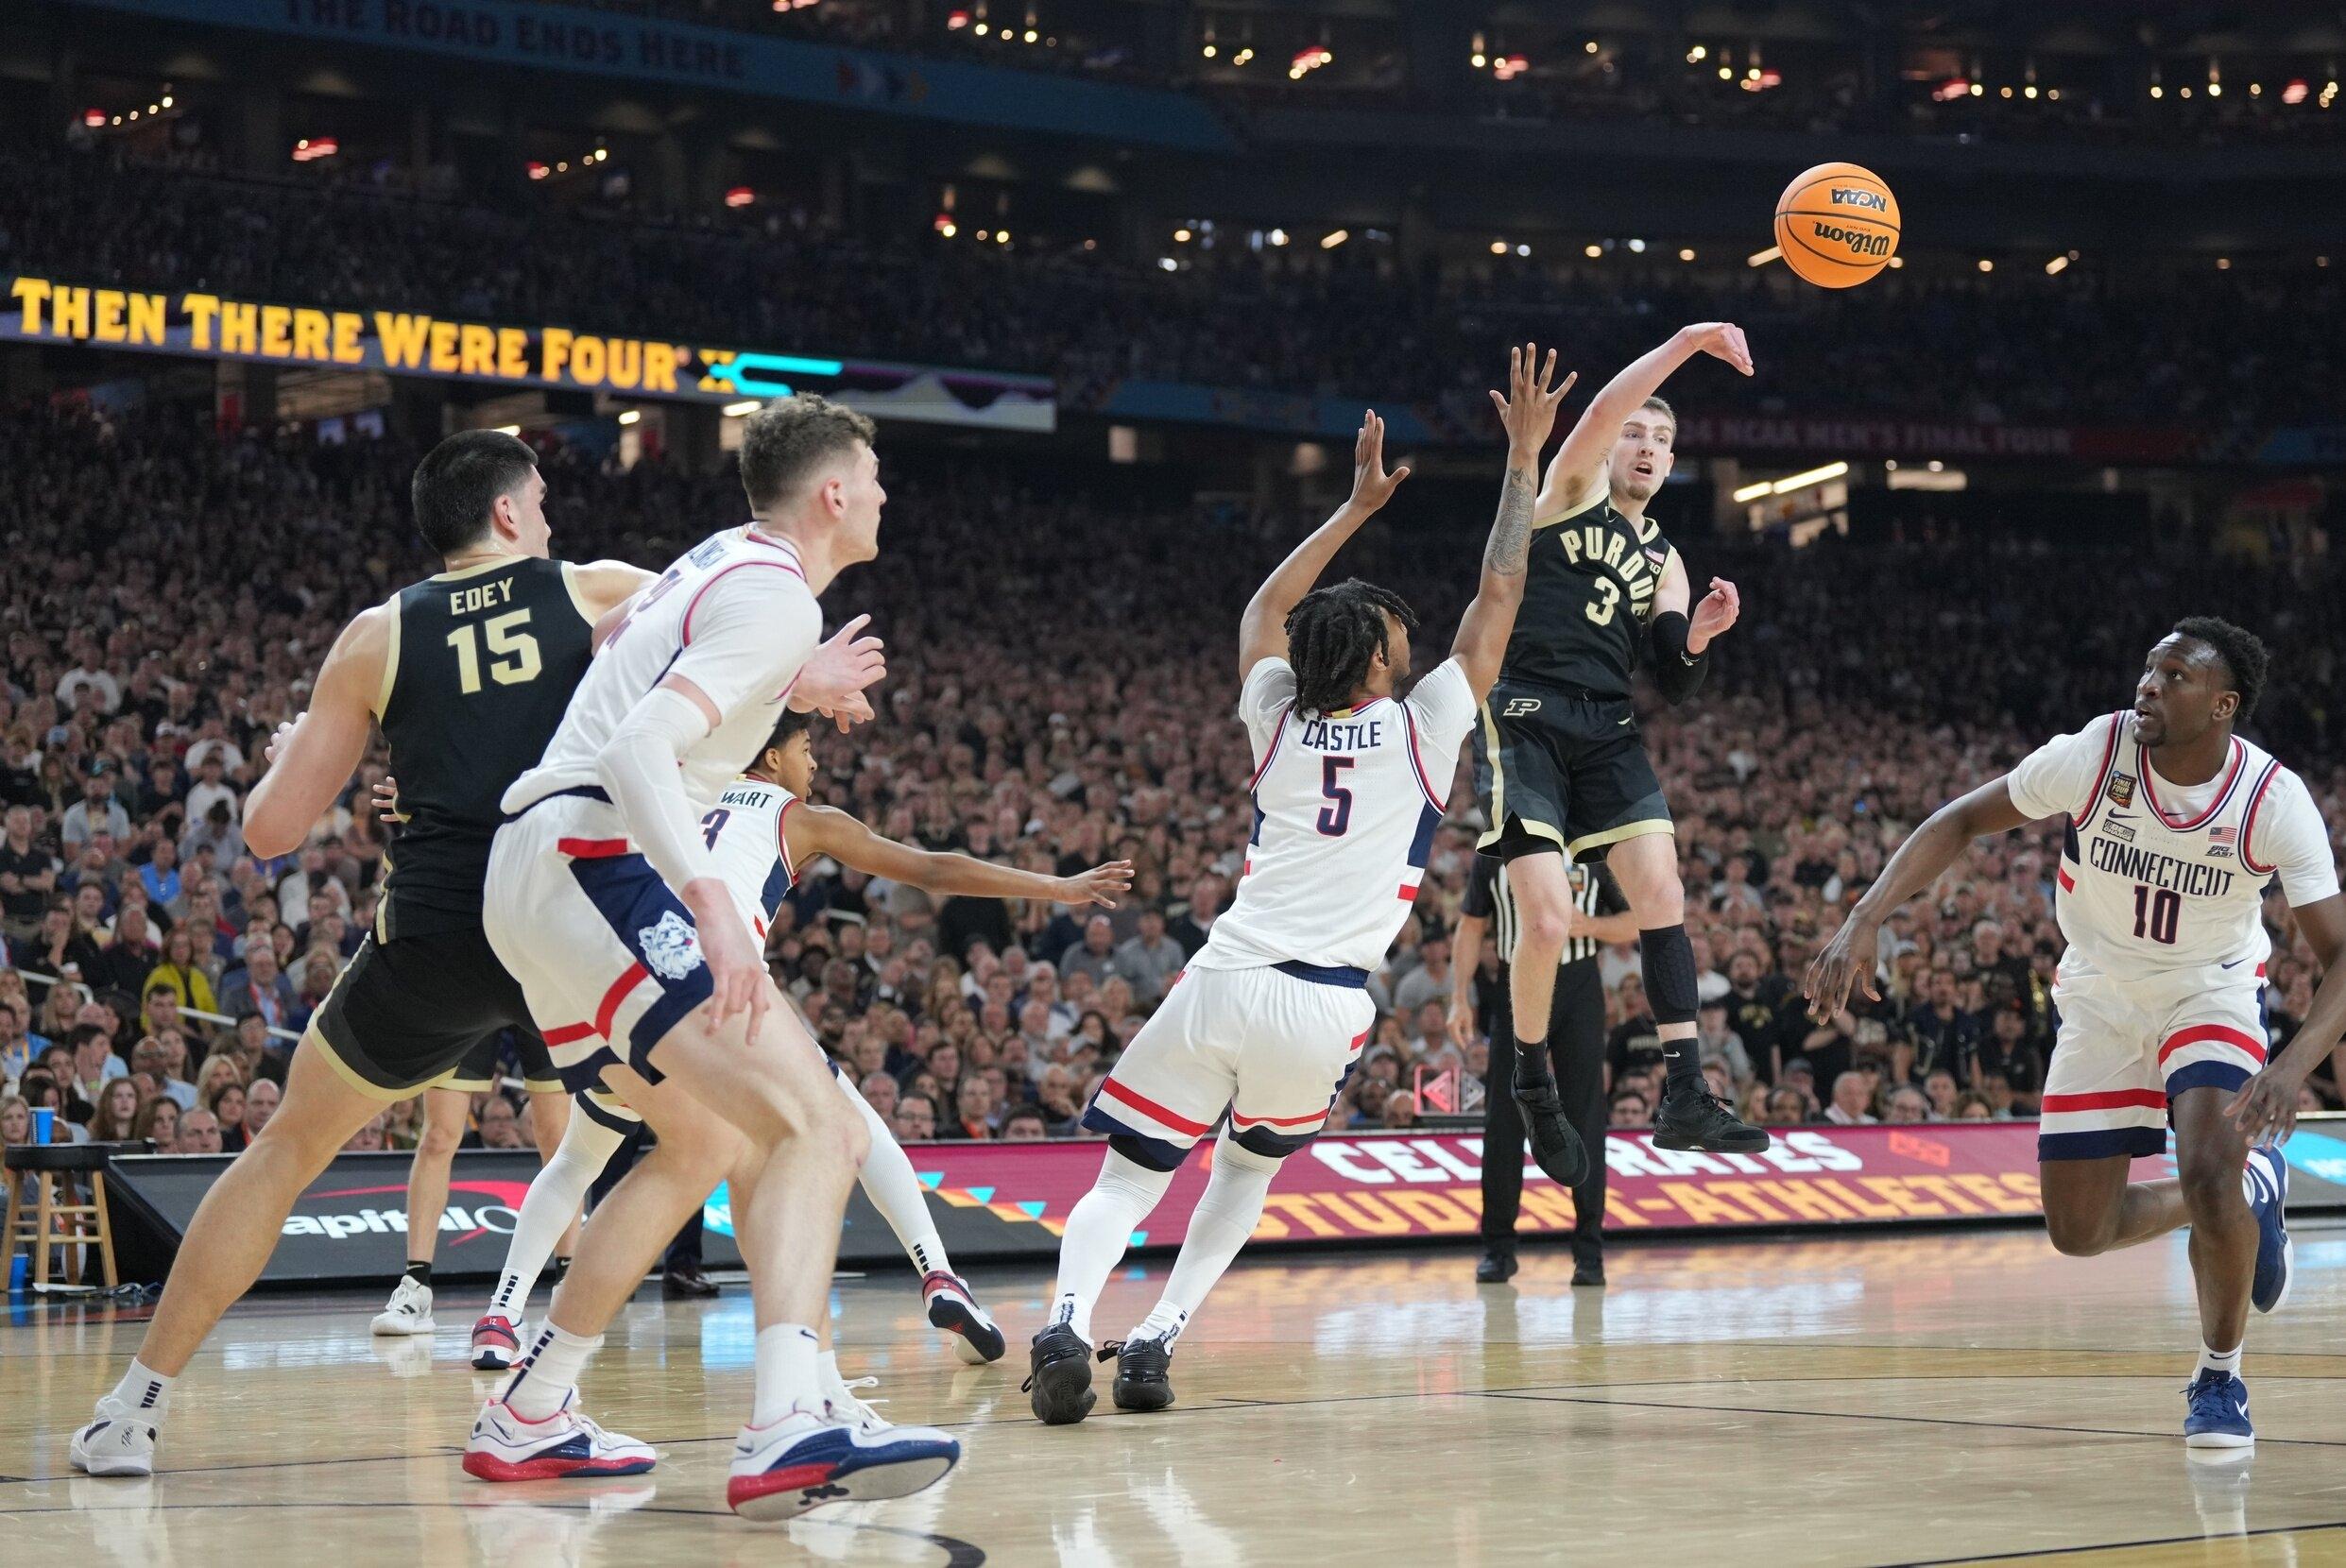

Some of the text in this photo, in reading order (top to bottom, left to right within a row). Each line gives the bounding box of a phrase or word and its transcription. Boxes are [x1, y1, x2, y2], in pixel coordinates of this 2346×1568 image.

[286, 0, 749, 77] THE ROAD ENDS HERE
[1830, 188, 1888, 213] NCAA
[1812, 221, 1890, 256] Wilson
[12, 277, 686, 392] THEN THERE WERE FOUR
[450, 576, 514, 616] EDEY
[1559, 525, 1655, 617] PURDUE
[1584, 575, 1620, 626] 3
[446, 606, 542, 694] 15
[1301, 719, 1381, 752] CASTLE
[1502, 698, 1542, 717] P
[719, 791, 774, 810] WART
[1316, 755, 1355, 838] 5
[2090, 836, 2235, 897] CONNECTICUT
[2132, 884, 2182, 945] 10
